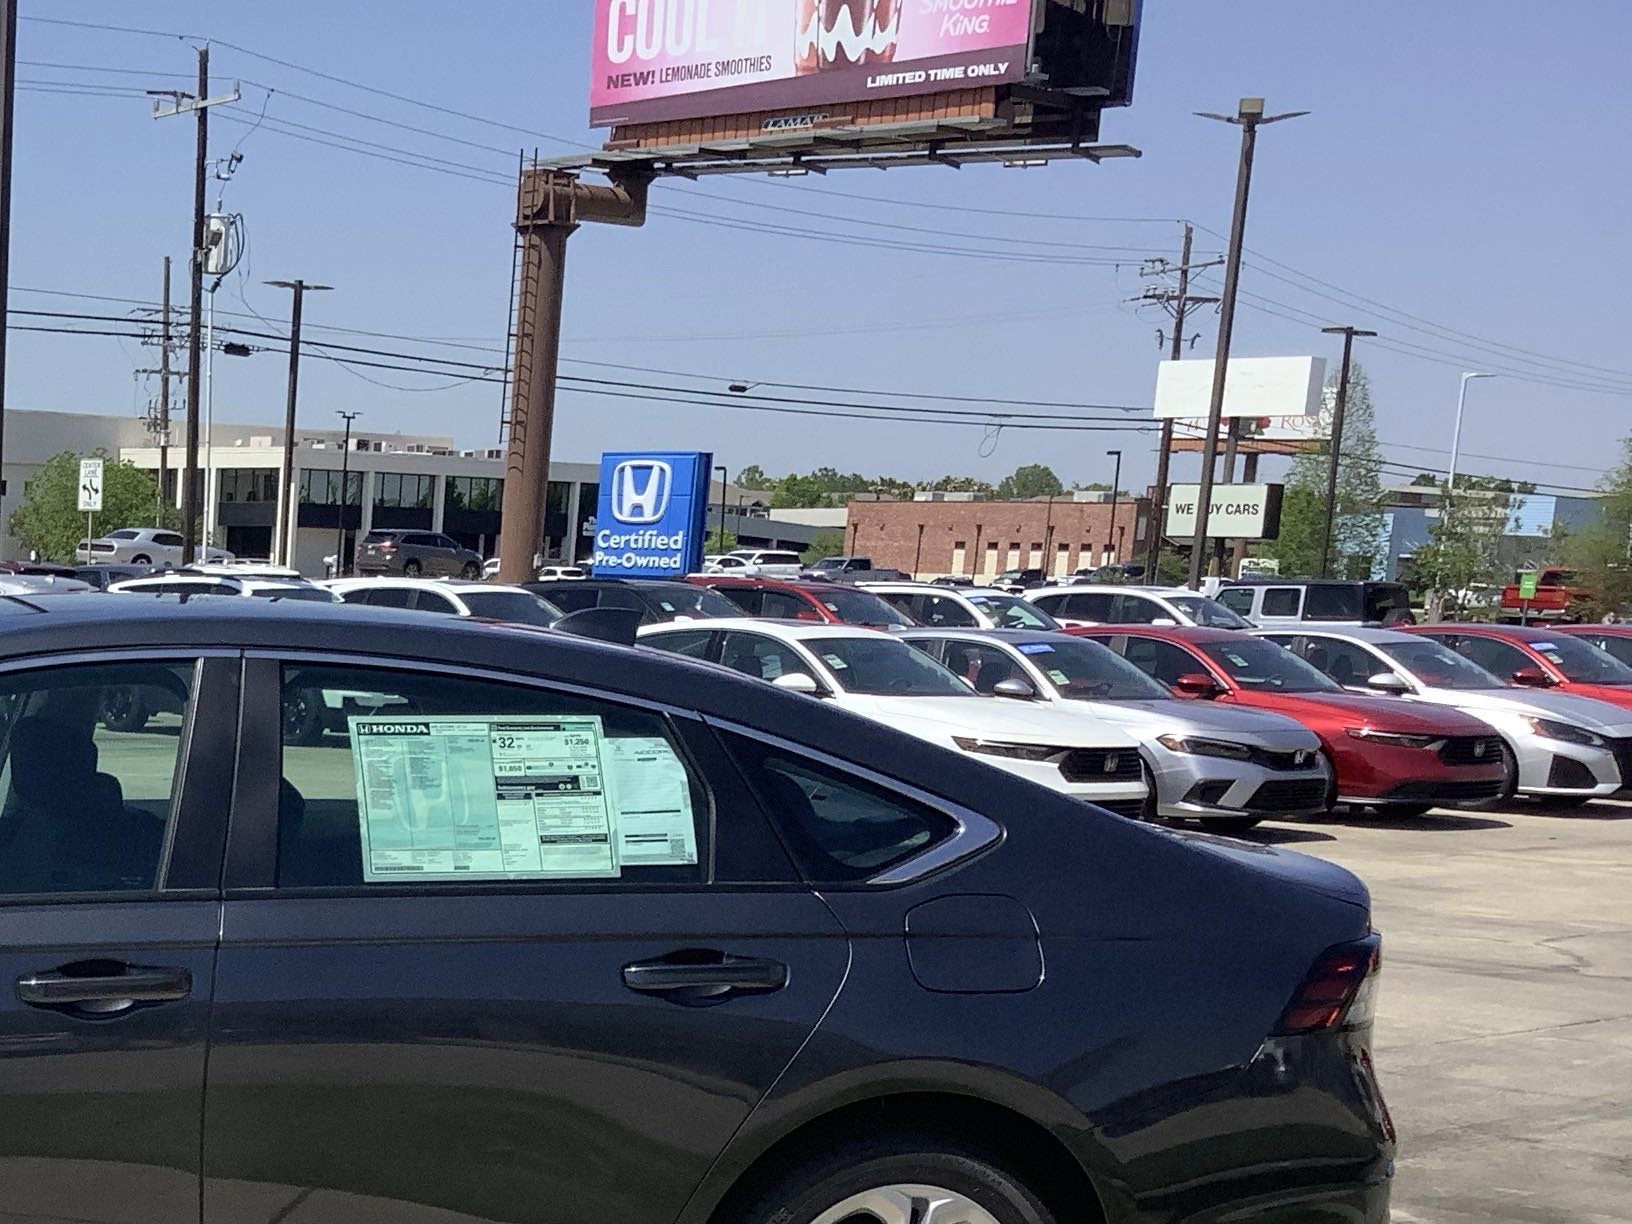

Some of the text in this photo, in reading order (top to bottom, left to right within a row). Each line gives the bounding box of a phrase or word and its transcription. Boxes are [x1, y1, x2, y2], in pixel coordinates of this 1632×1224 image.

[607, 0, 719, 63] COOL
[607, 55, 772, 90] NEW! LEMONADE SMOOTHIES
[866, 62, 1009, 88] LIMITED TIME ONLY
[1175, 503, 1194, 515] WE
[1225, 503, 1259, 515] CARS
[597, 529, 683, 549] Certified
[594, 551, 681, 568] Pre-Owned
[372, 725, 428, 734] HONDA
[498, 737, 515, 749] 32
